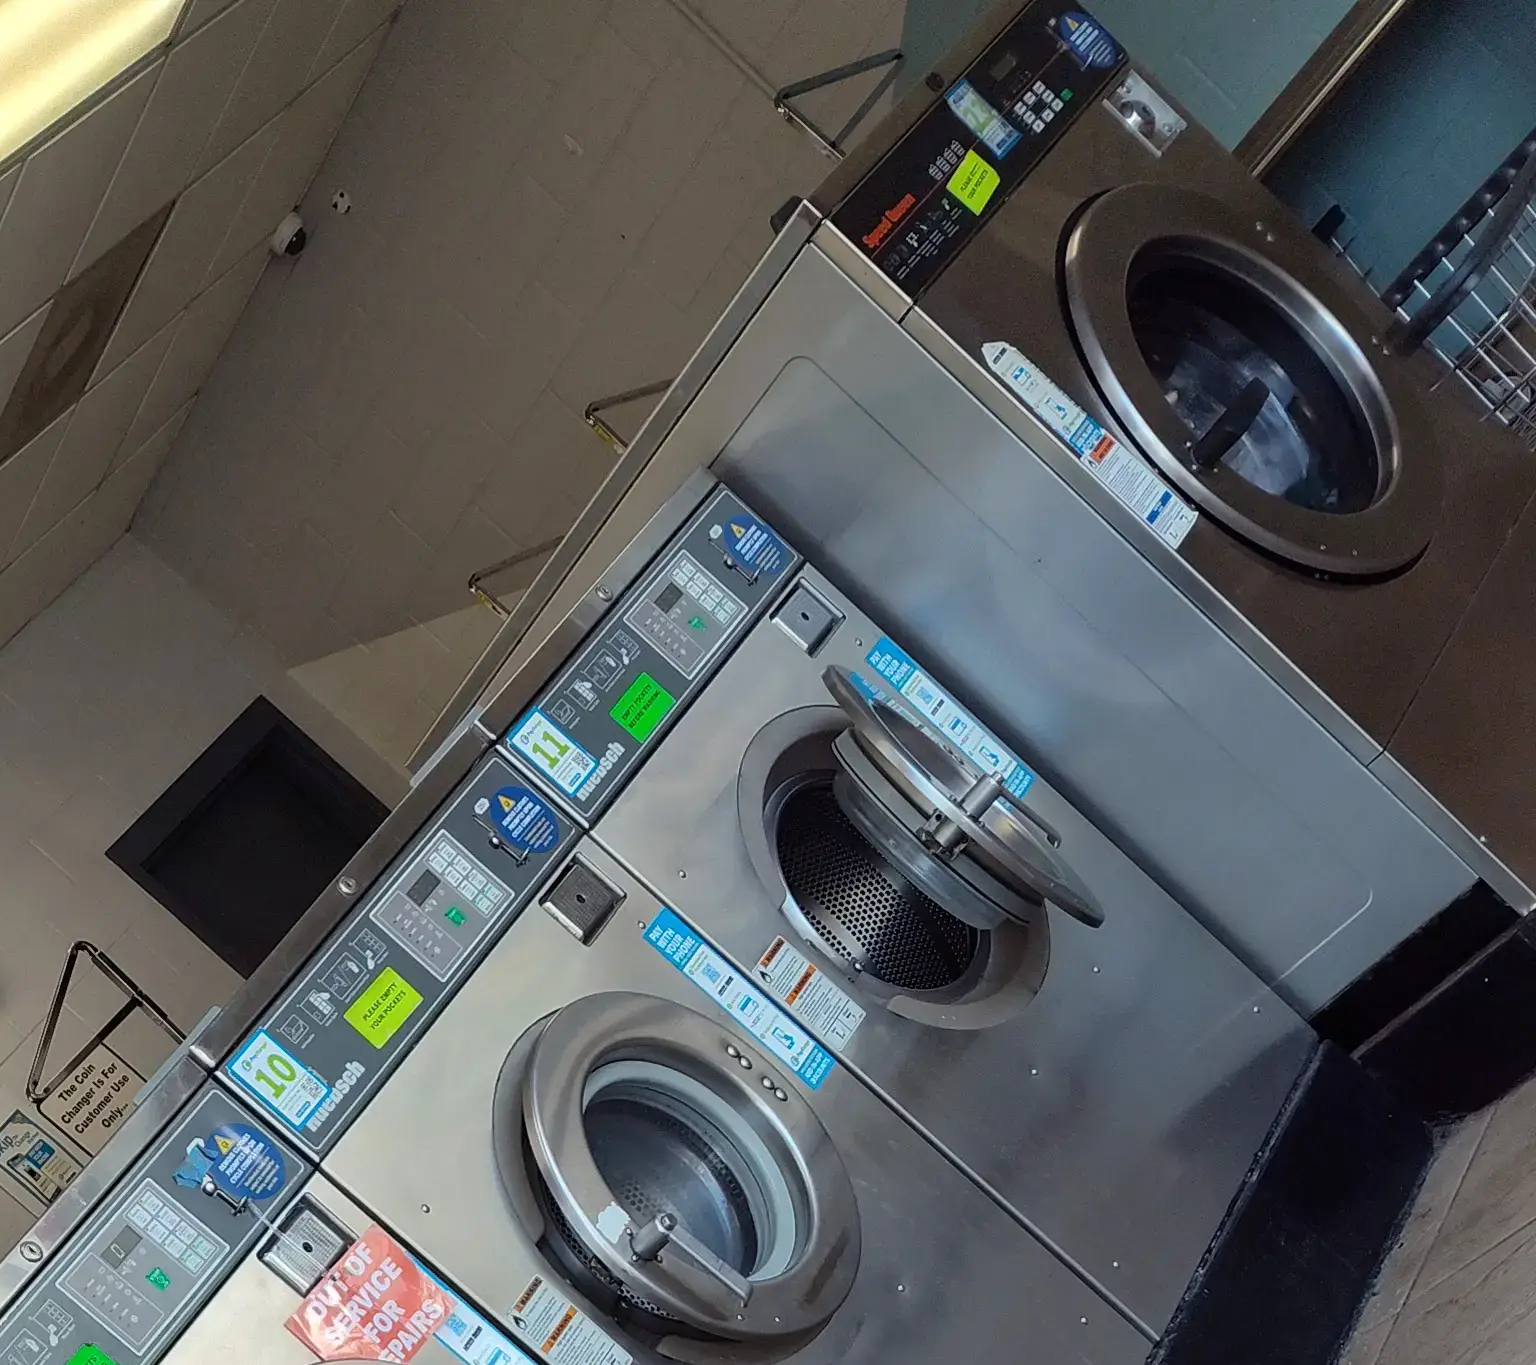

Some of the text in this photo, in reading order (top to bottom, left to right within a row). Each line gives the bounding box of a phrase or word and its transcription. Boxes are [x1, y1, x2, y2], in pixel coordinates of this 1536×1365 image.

[860, 190, 917, 249] Speed Queen
[869, 649, 883, 664] PAY
[875, 652, 893, 672] WITH
[883, 658, 901, 678] YOUR
[889, 661, 911, 686] PHONE
[632, 682, 653, 707] POCKETS
[529, 726, 571, 771] 11
[648, 924, 664, 942] PAY
[656, 927, 676, 949] WITH
[663, 932, 684, 956] YOUR
[671, 934, 696, 963] PHONE
[361, 980, 399, 1022] PLEASE EMPTY
[369, 988, 407, 1032] YOUR POCKETS
[56, 1061, 97, 1103] The Coin
[59, 1060, 119, 1127] Changer Is For
[251, 1048, 300, 1101] 10
[73, 1072, 130, 1135] Customer Use
[306, 1241, 378, 1321] OUT OF
[320, 1255, 405, 1349] SERVICE
[361, 1297, 406, 1344] FOR
